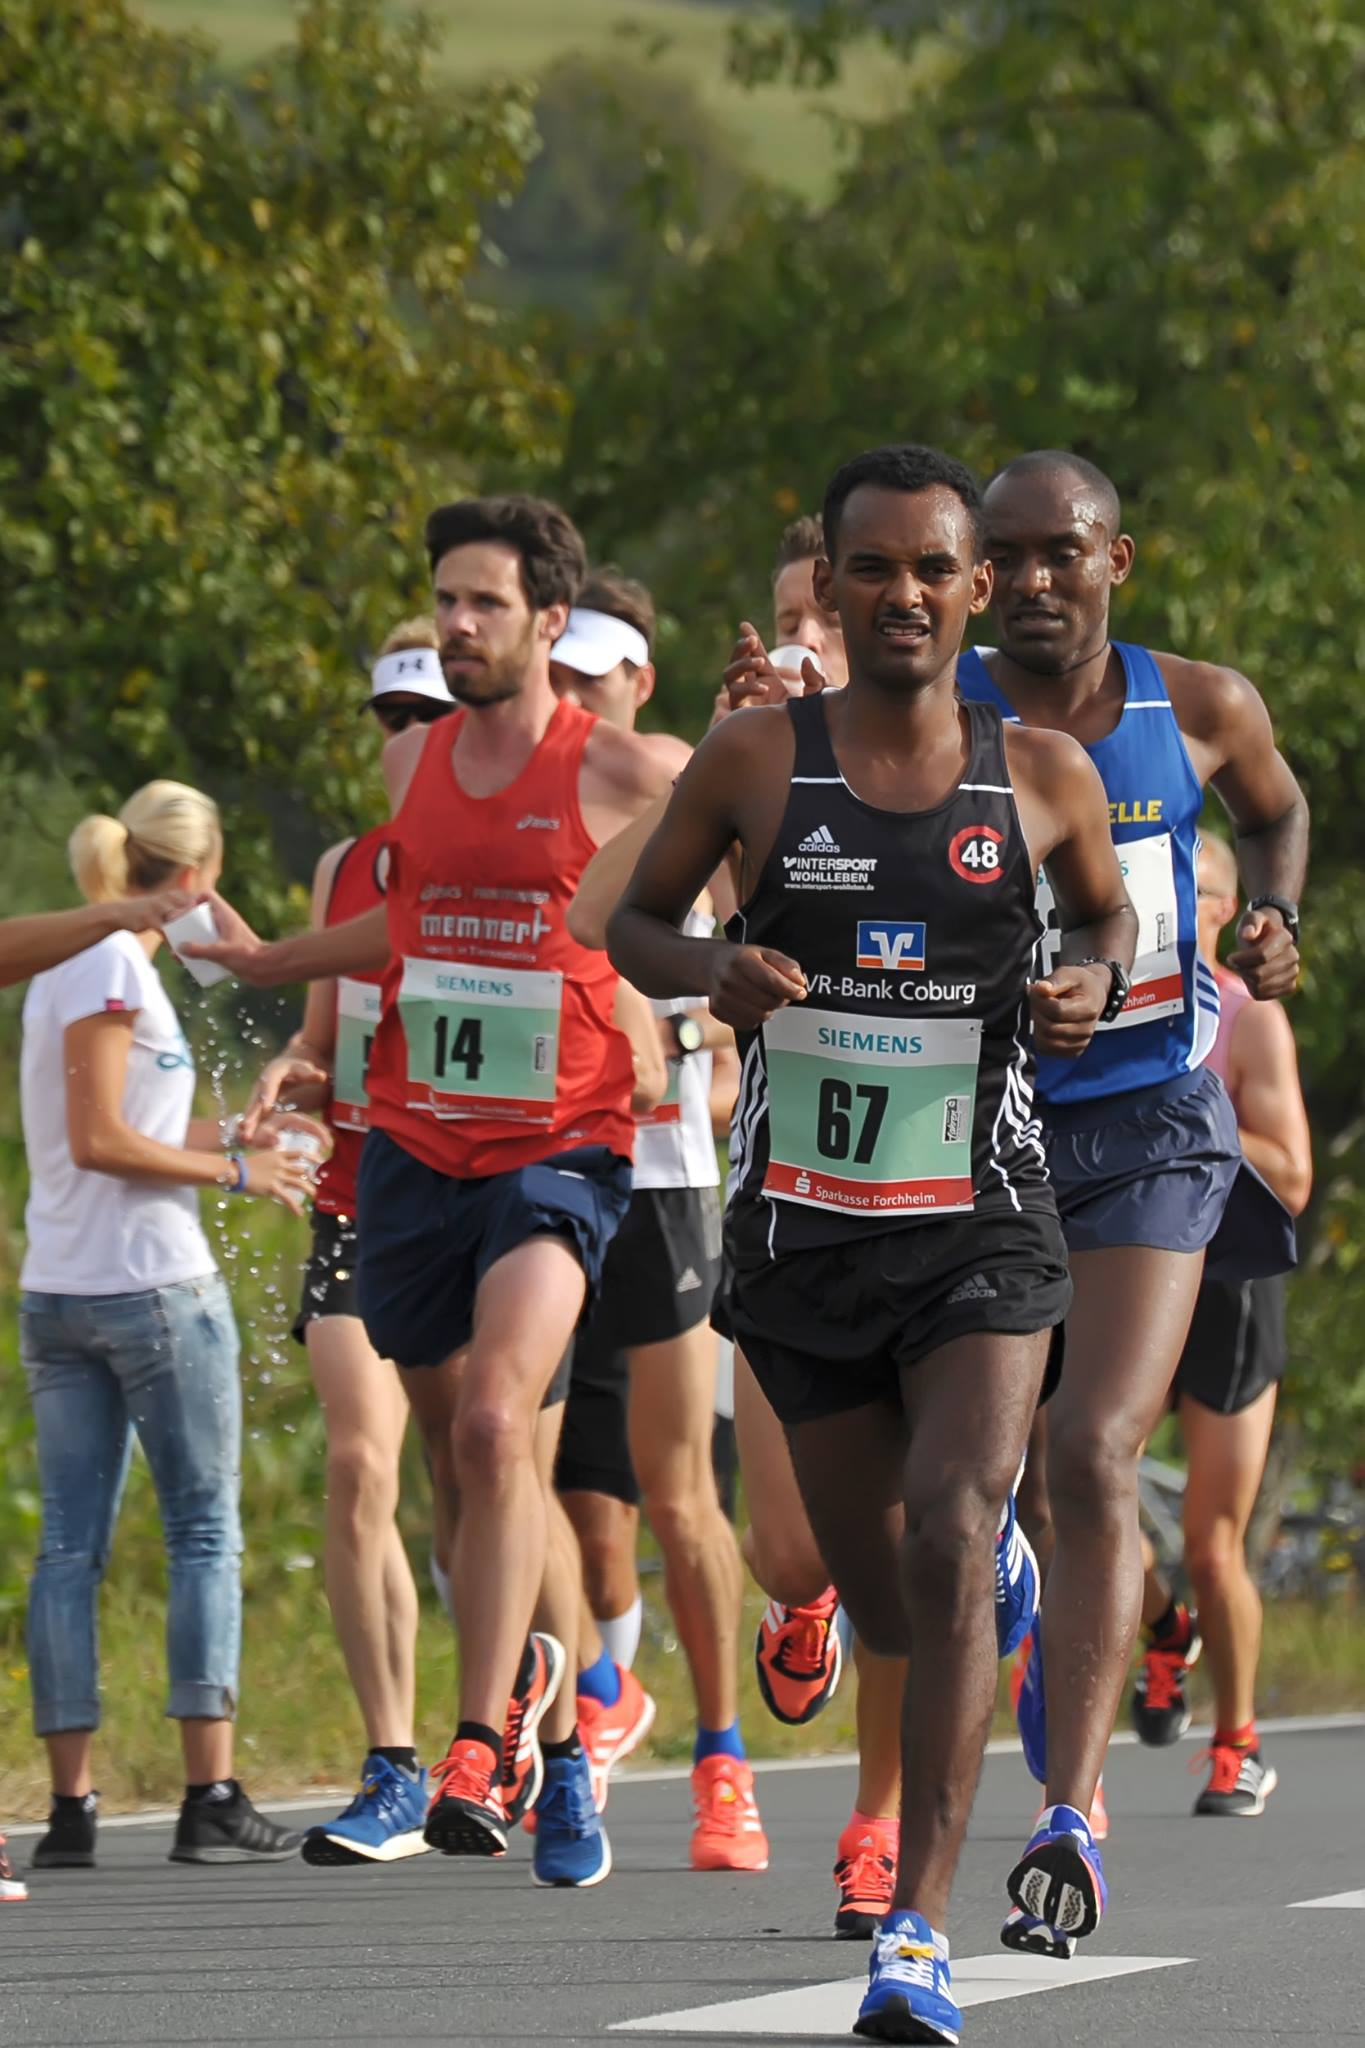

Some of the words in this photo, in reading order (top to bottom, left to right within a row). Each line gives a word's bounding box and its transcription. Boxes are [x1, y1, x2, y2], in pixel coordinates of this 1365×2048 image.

[798, 842, 841, 854] adidas
[797, 857, 878, 871] INTERSPORT
[789, 871, 869, 883] WOHLLEBEN
[436, 975, 513, 997] SIEMENS
[803, 973, 893, 1000] VR-Bank
[899, 980, 977, 1004] Coburg
[433, 1015, 484, 1081] 14
[818, 1027, 923, 1054] SIEMENS
[816, 1078, 890, 1164] 67
[815, 1186, 870, 1207] Sparkasse
[873, 1192, 936, 1207] Forchheim
